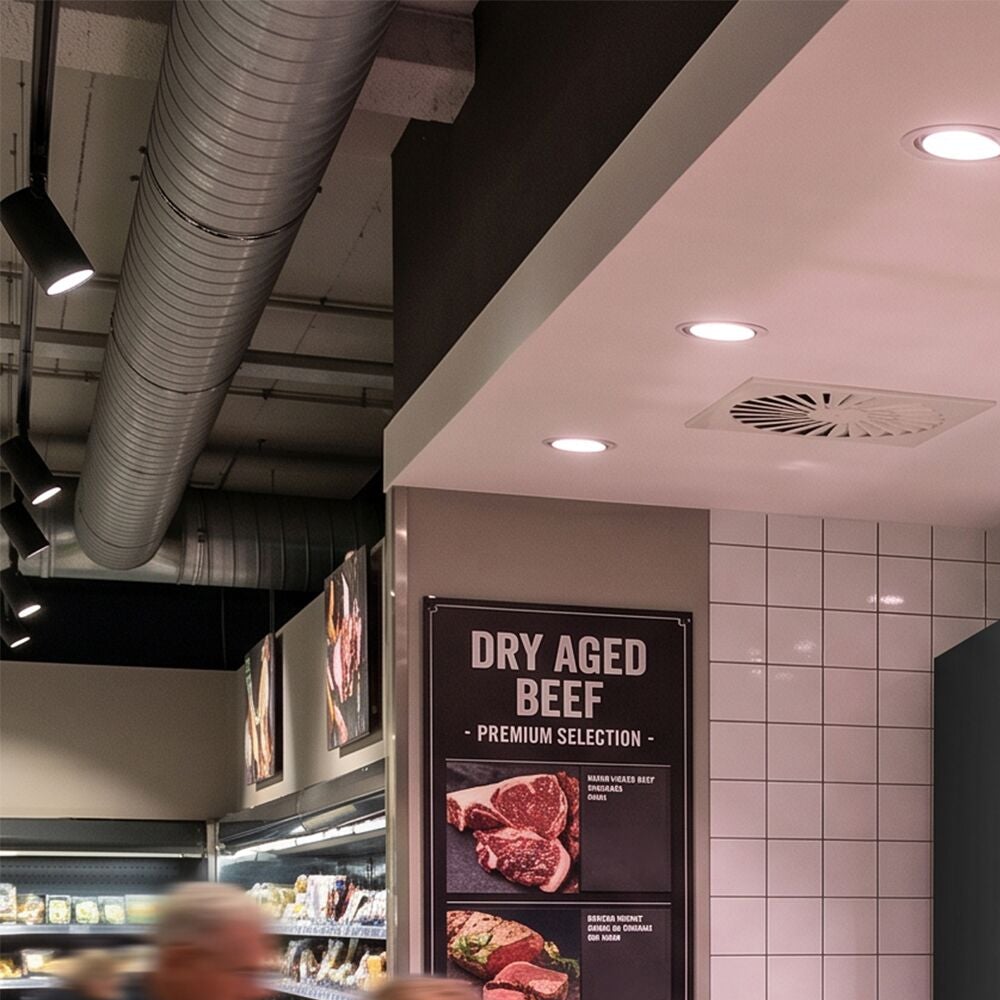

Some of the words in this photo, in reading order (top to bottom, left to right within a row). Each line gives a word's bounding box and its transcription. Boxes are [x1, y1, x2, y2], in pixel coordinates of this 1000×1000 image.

[471, 630, 544, 671] DRY
[553, 635, 647, 677] AGED
[516, 678, 604, 719] BEEF
[477, 724, 552, 745] PREMIUM
[557, 728, 641, 747] SELECTION
